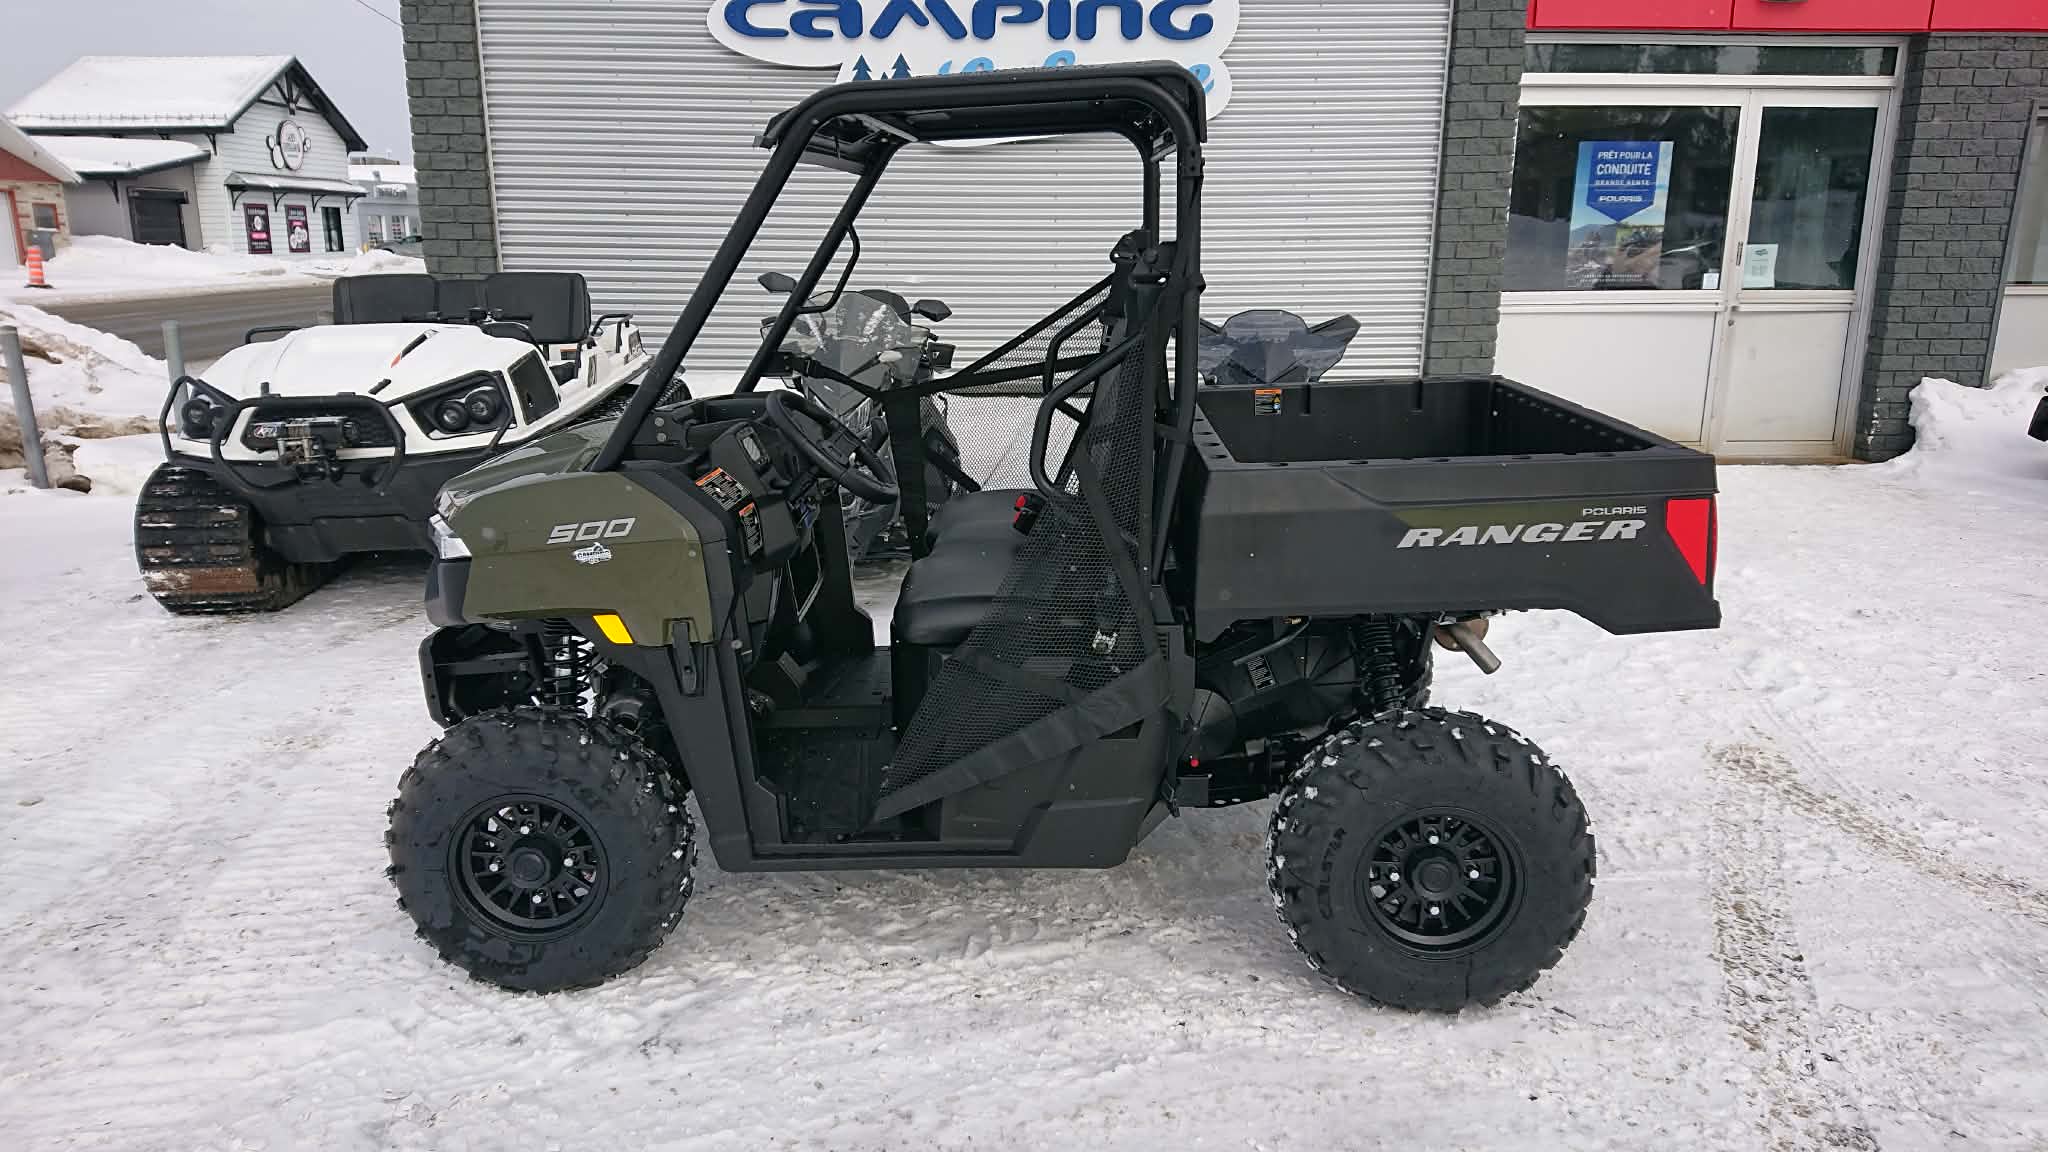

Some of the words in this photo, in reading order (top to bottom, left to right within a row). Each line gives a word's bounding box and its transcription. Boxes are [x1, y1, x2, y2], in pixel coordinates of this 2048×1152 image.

[1642, 151, 1653, 159] LA
[1596, 163, 1652, 175] CONDUITE
[1582, 506, 1647, 517] POLARIS
[546, 517, 637, 545] 500
[1396, 519, 1647, 549] RANGER
